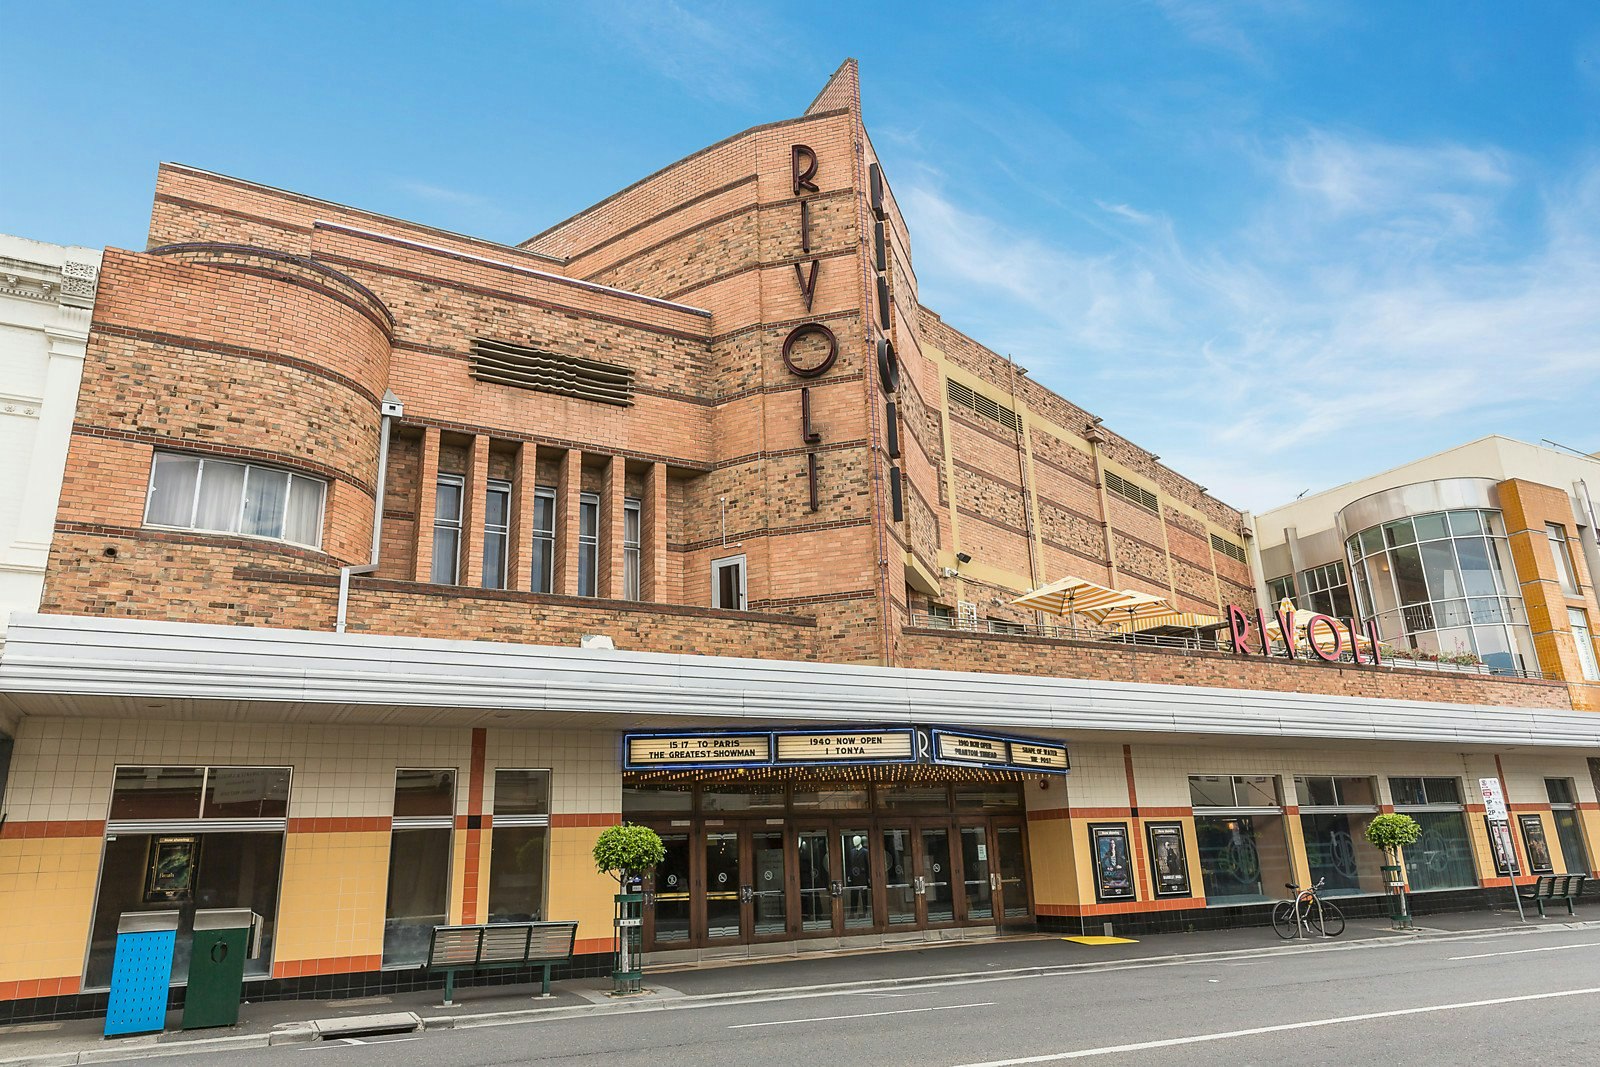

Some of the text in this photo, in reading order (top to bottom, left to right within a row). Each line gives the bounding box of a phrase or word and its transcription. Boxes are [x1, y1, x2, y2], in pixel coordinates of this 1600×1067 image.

[782, 144, 839, 512] RIVOLI
[1226, 604, 1382, 666] RIVOLI
[669, 750, 711, 758] GREATEST
[714, 749, 756, 757] SHOWMAN
[917, 730, 930, 758] R
